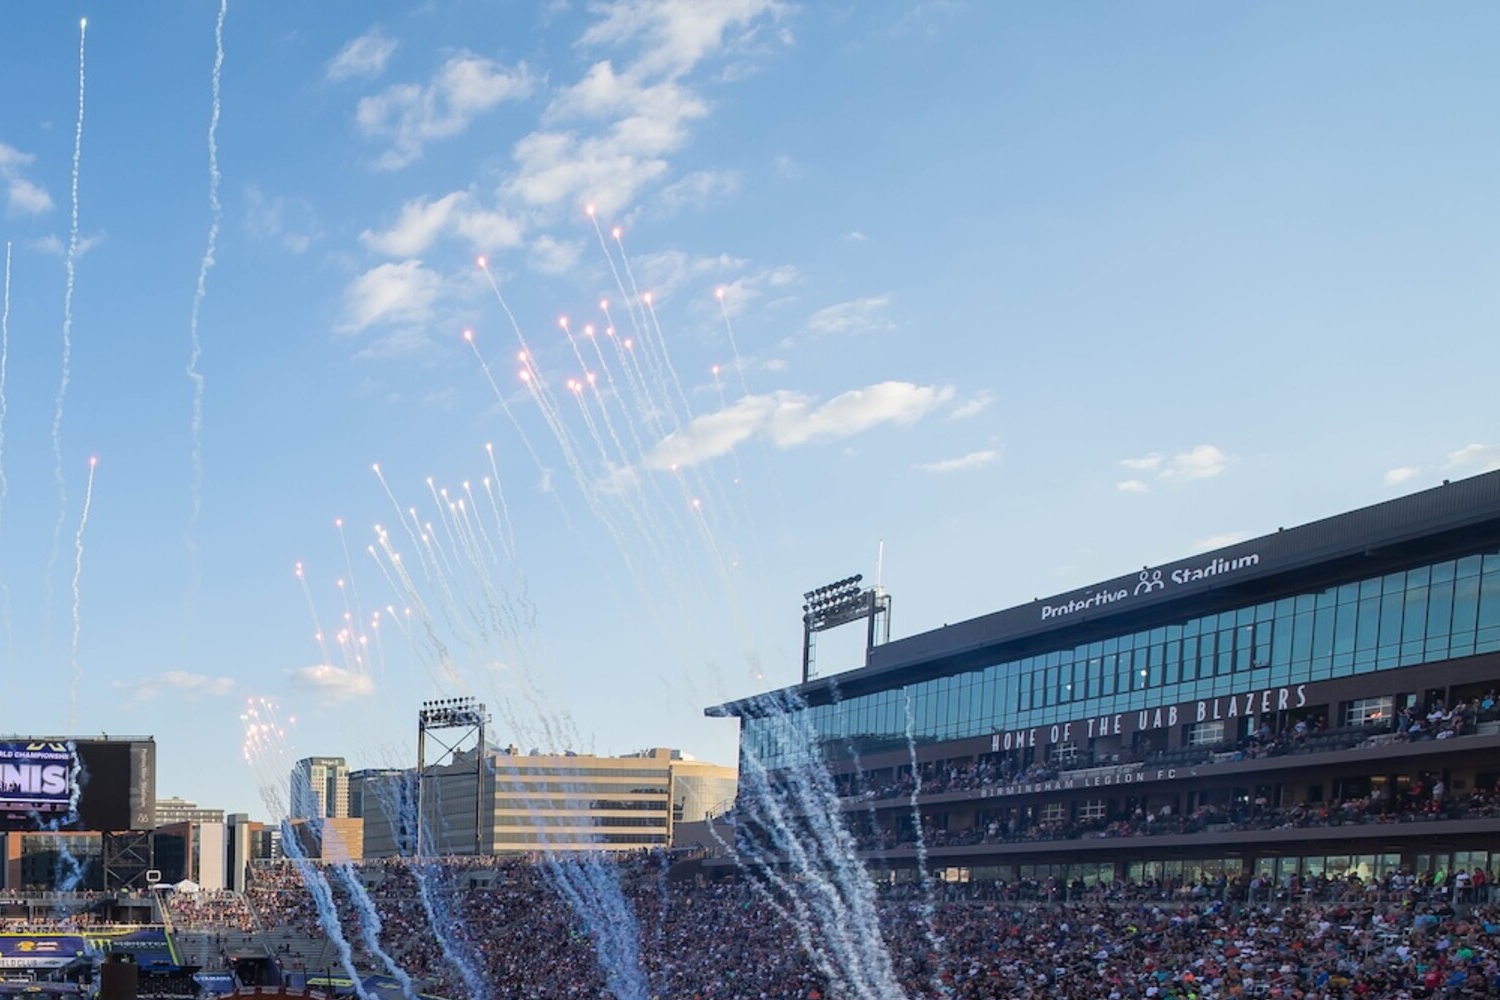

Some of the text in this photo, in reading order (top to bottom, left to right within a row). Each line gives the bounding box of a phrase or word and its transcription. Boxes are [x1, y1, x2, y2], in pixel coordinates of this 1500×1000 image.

[1041, 553, 1260, 620] Protective Stadium
[991, 684, 1307, 752] HOME OF THE UAB BLAZERS
[980, 768, 1177, 797] BIRMINGHAM LEGION FC
